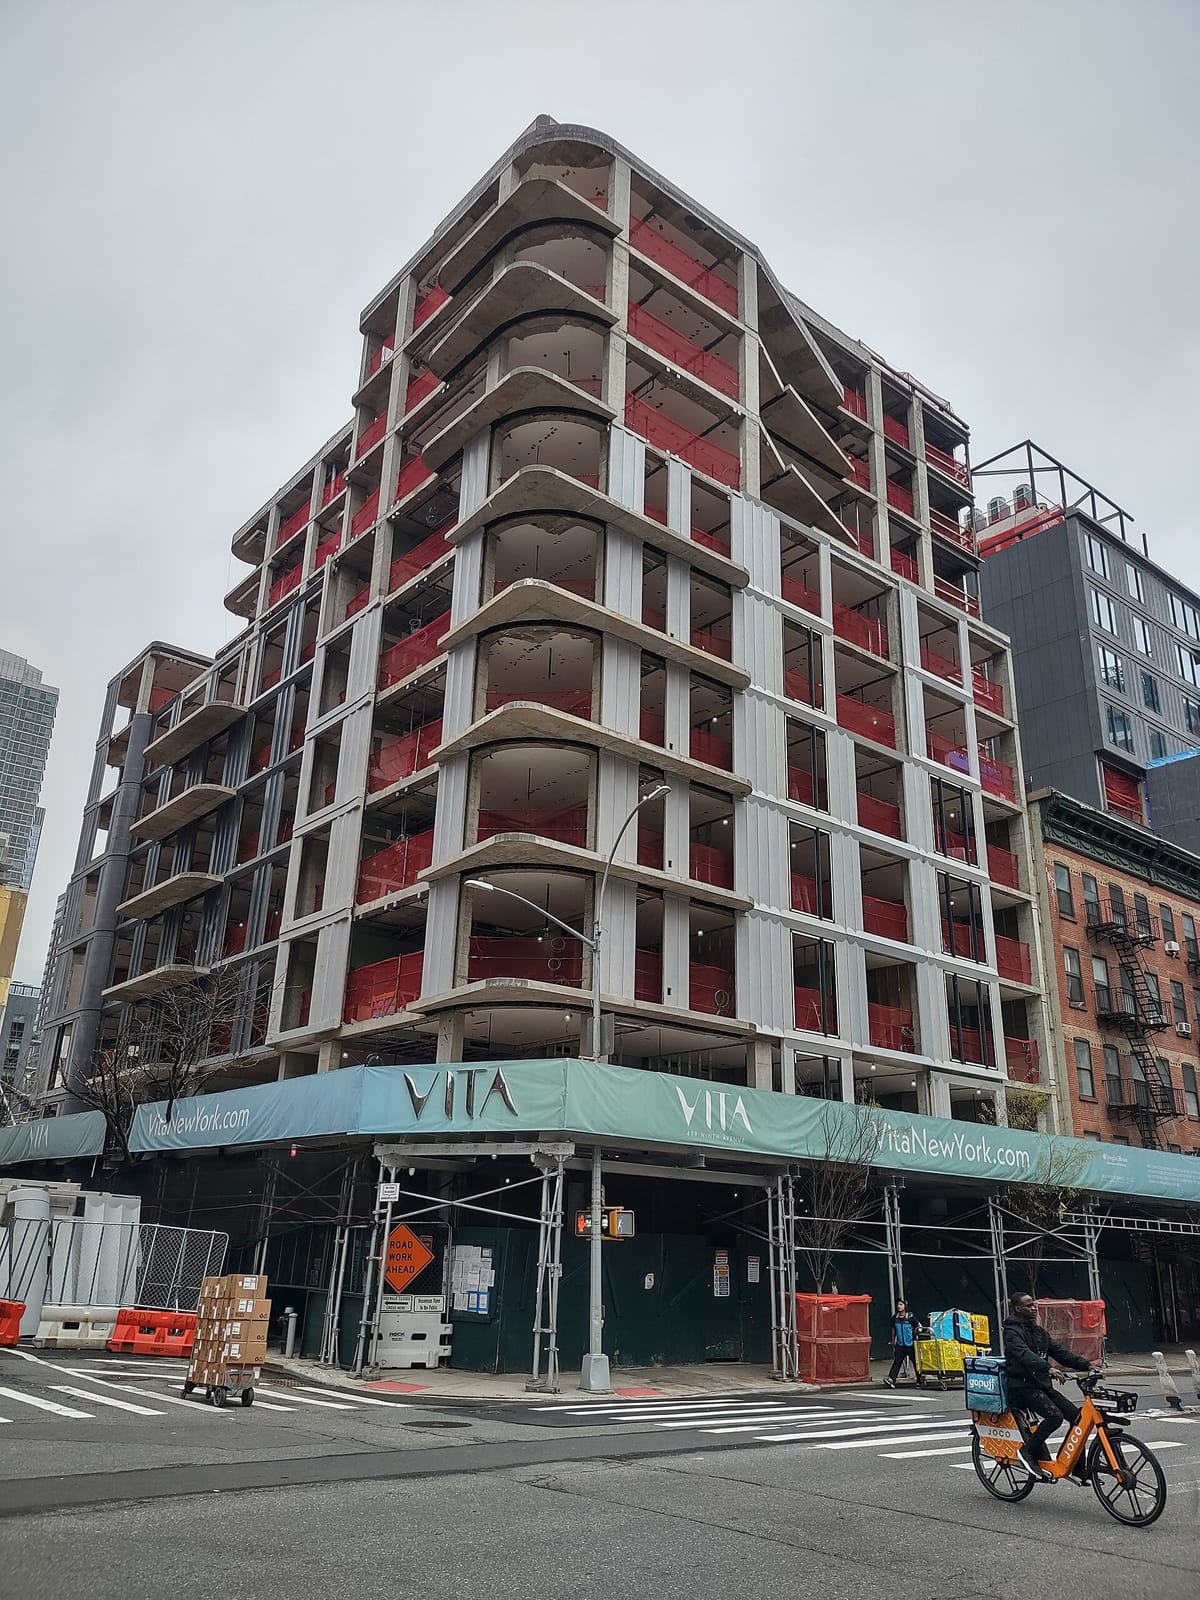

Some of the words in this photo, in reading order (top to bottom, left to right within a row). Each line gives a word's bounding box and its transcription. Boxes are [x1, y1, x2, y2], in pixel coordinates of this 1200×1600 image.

[402, 1067, 518, 1120] VITA
[148, 1104, 250, 1137] VitaNewYork.com
[676, 1085, 754, 1134] VITA
[870, 1121, 1031, 1168] VitaNewYork.com
[389, 1240, 413, 1249] ROAD
[389, 1253, 412, 1261] WORK
[386, 1265, 415, 1273] AHEAD
[969, 1377, 995, 1391] gopuff
[987, 1429, 1011, 1438] JOCO
[1064, 1425, 1083, 1459] JOCO
